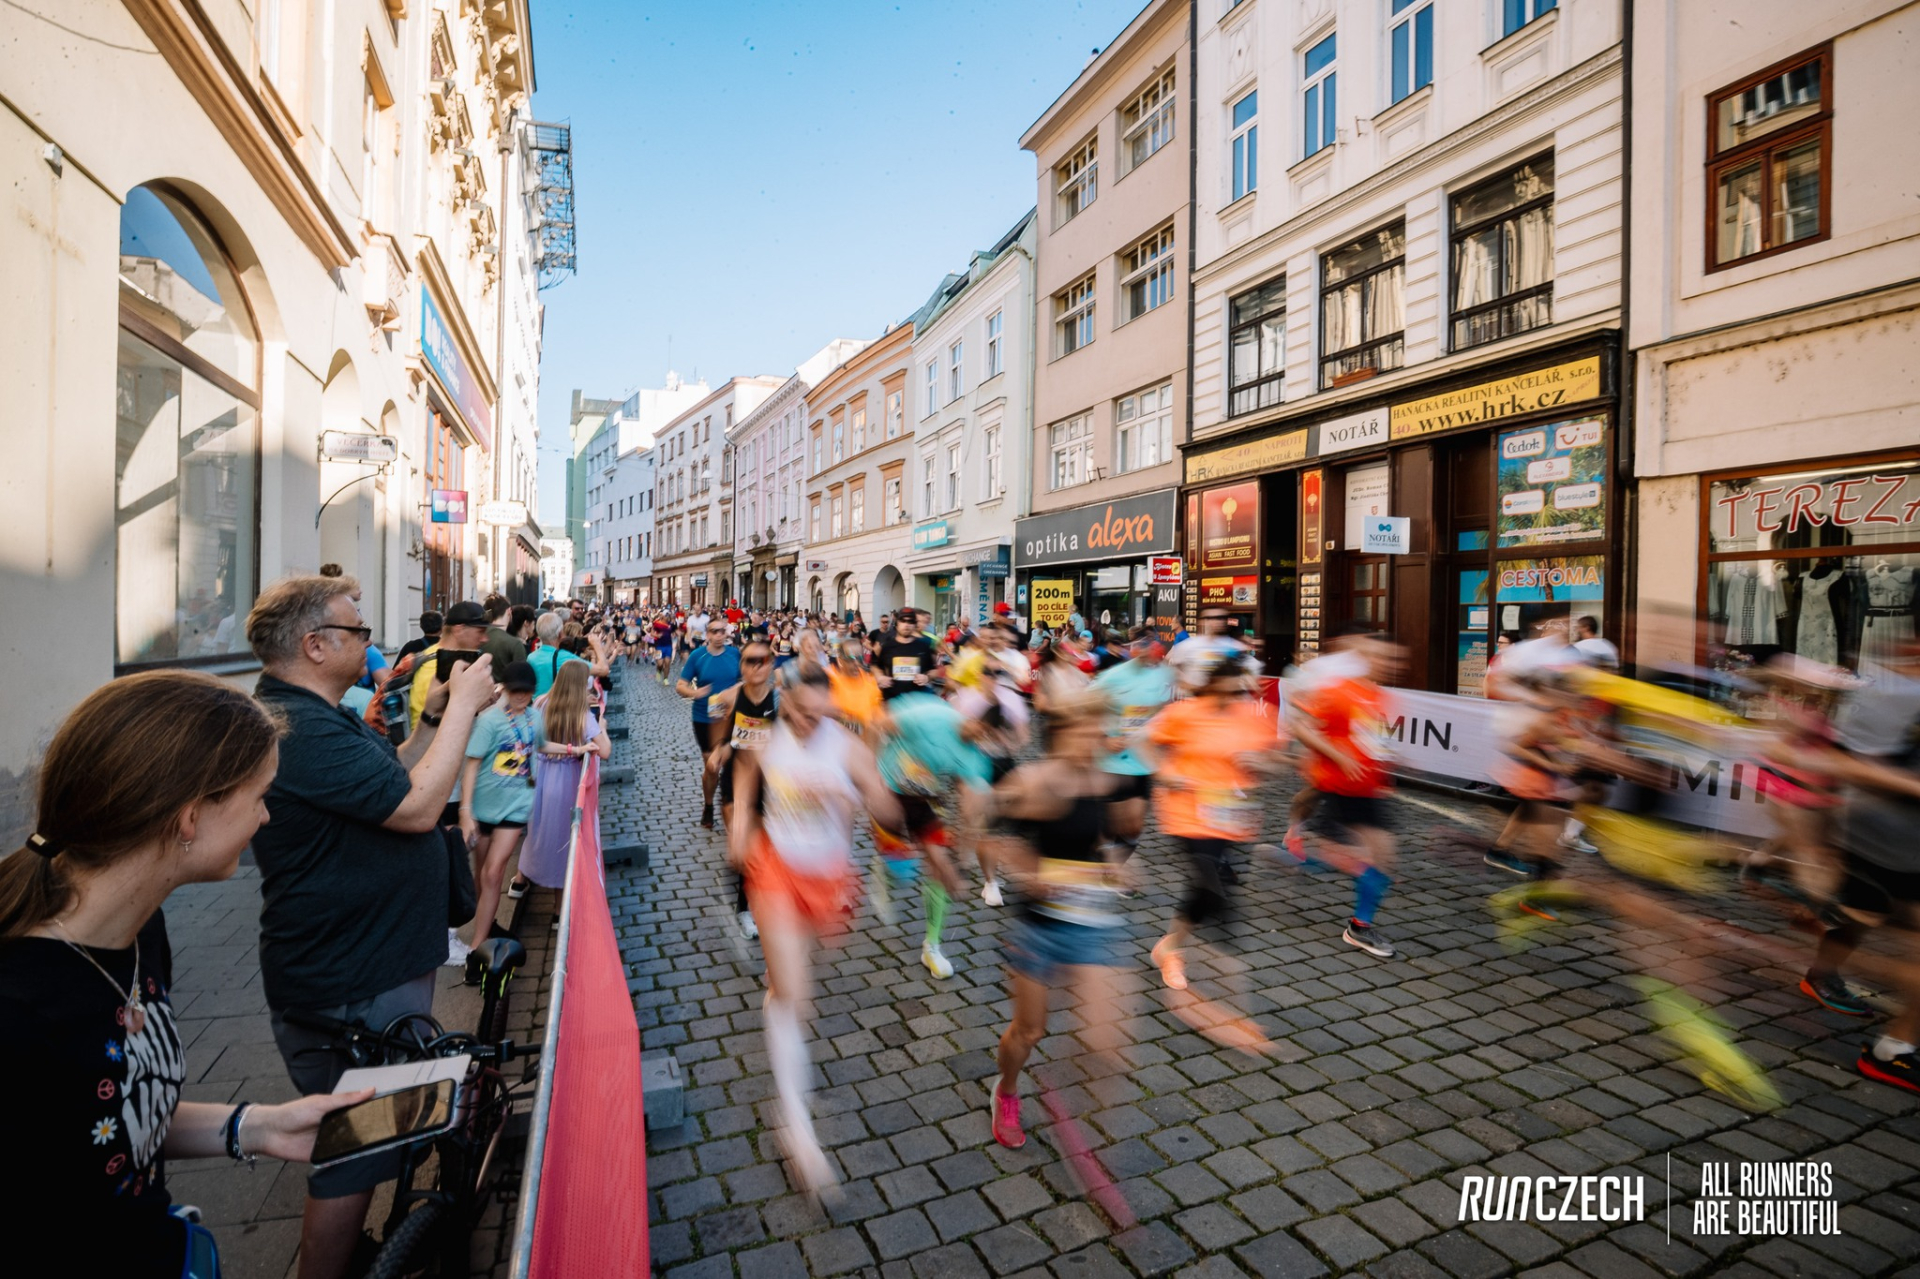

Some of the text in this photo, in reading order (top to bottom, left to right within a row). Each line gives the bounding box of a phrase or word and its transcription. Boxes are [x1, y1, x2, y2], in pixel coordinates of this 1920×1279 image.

[1393, 396, 1440, 419] HANÁCKÁ
[1442, 383, 1492, 408] REALITNÍ
[1569, 366, 1596, 379] s.r.o.
[1418, 389, 1567, 432] www.hrk.cz
[1328, 418, 1379, 444] NOTÁŘ
[1581, 431, 1598, 441] TUI
[1190, 464, 1214, 480] HRK
[1026, 505, 1154, 560] optika alexa
[1500, 566, 1600, 588] CESTOMA
[978, 575, 991, 627] SMĚNÁ
[1209, 587, 1225, 597] PHO
[1050, 602, 1068, 610] CÍLE
